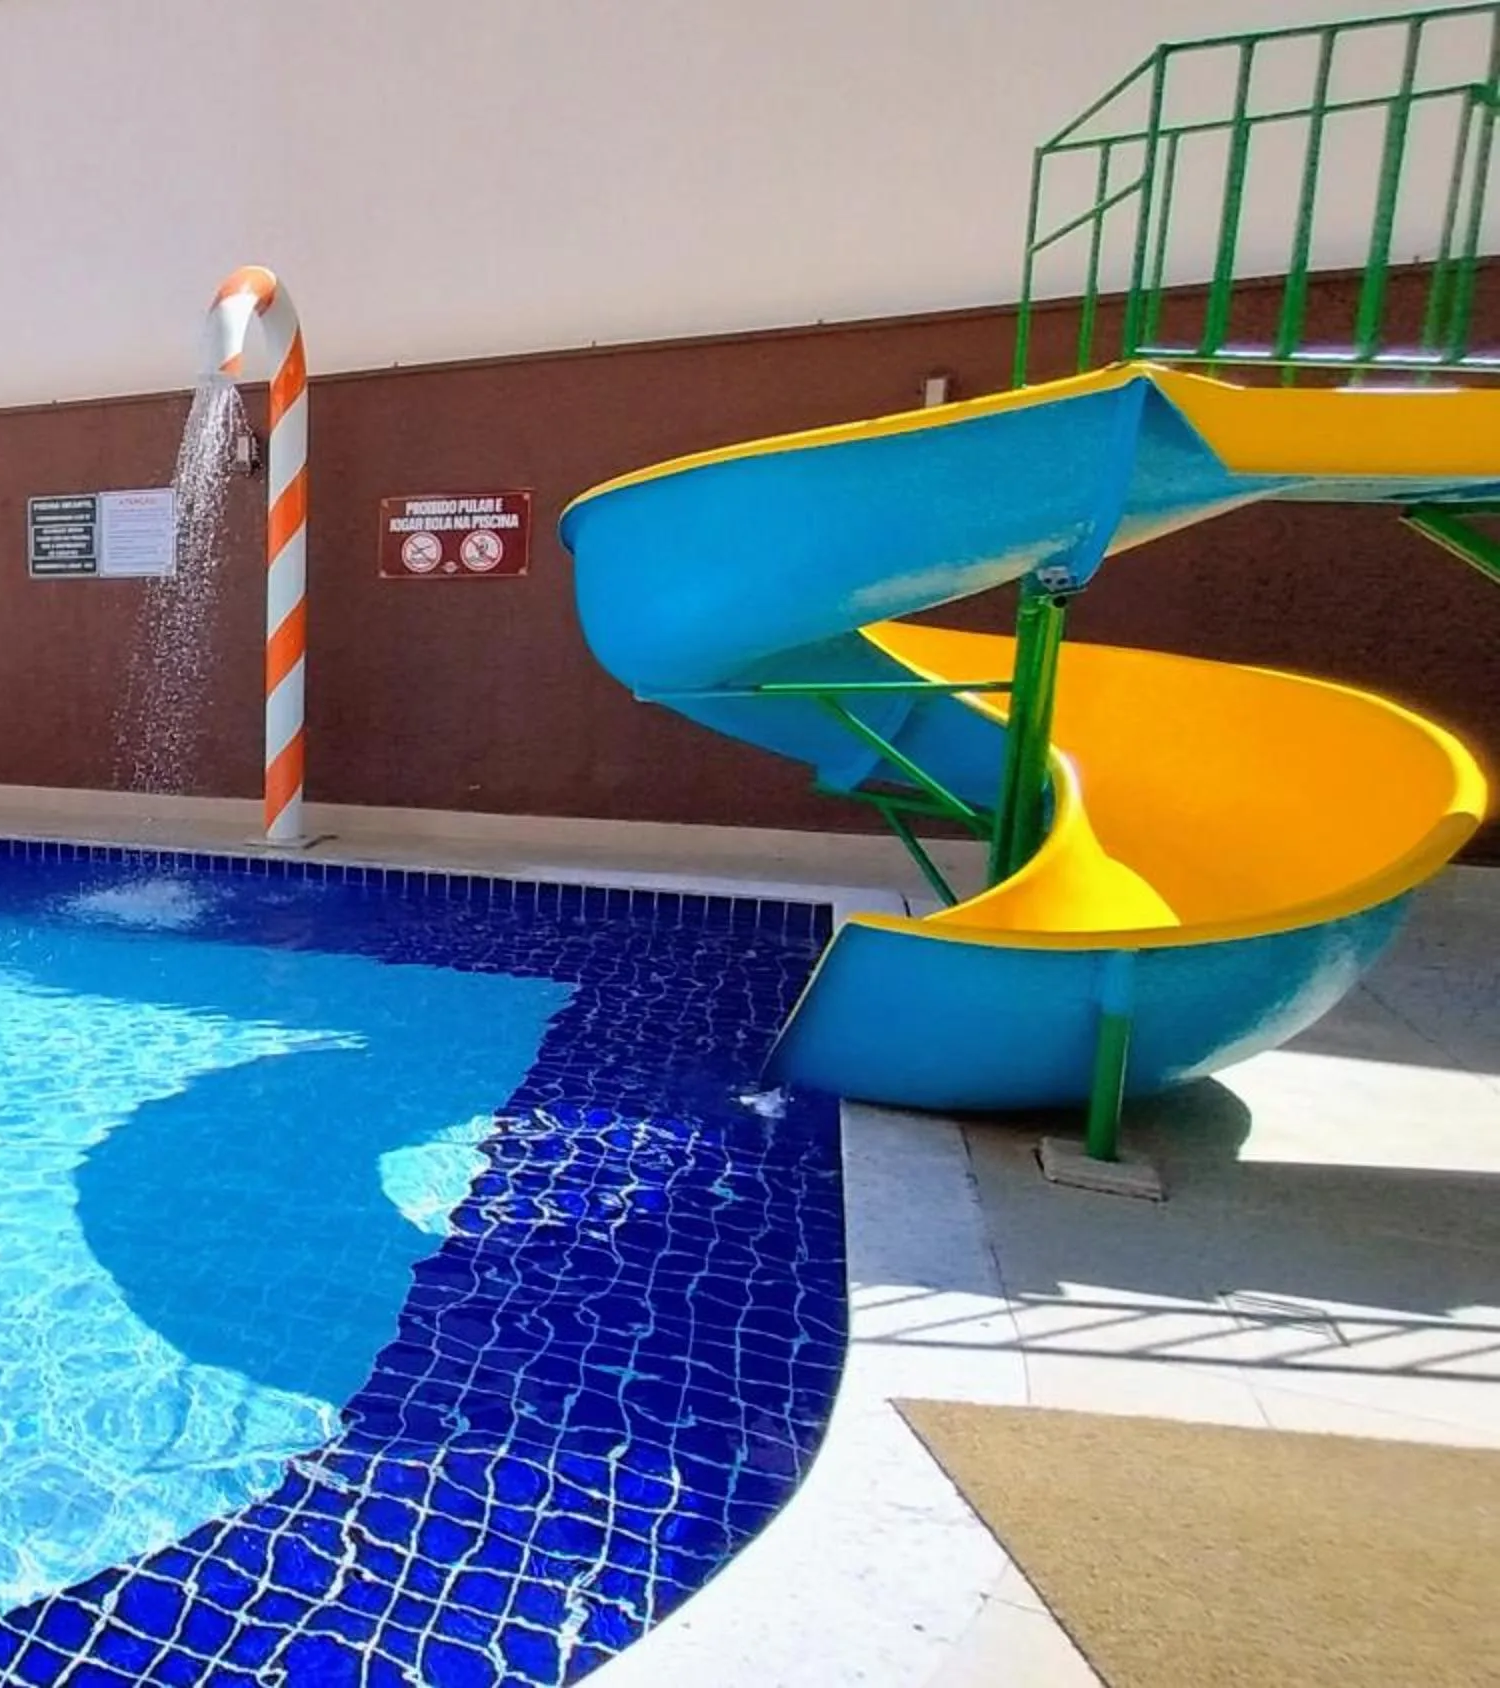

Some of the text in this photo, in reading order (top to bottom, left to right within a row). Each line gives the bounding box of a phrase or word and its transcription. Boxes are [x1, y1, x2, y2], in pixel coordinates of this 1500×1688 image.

[405, 498, 504, 516] PROIBIDO PULAR E
[389, 513, 519, 532] JOGAR BOLA NA PISCINA
